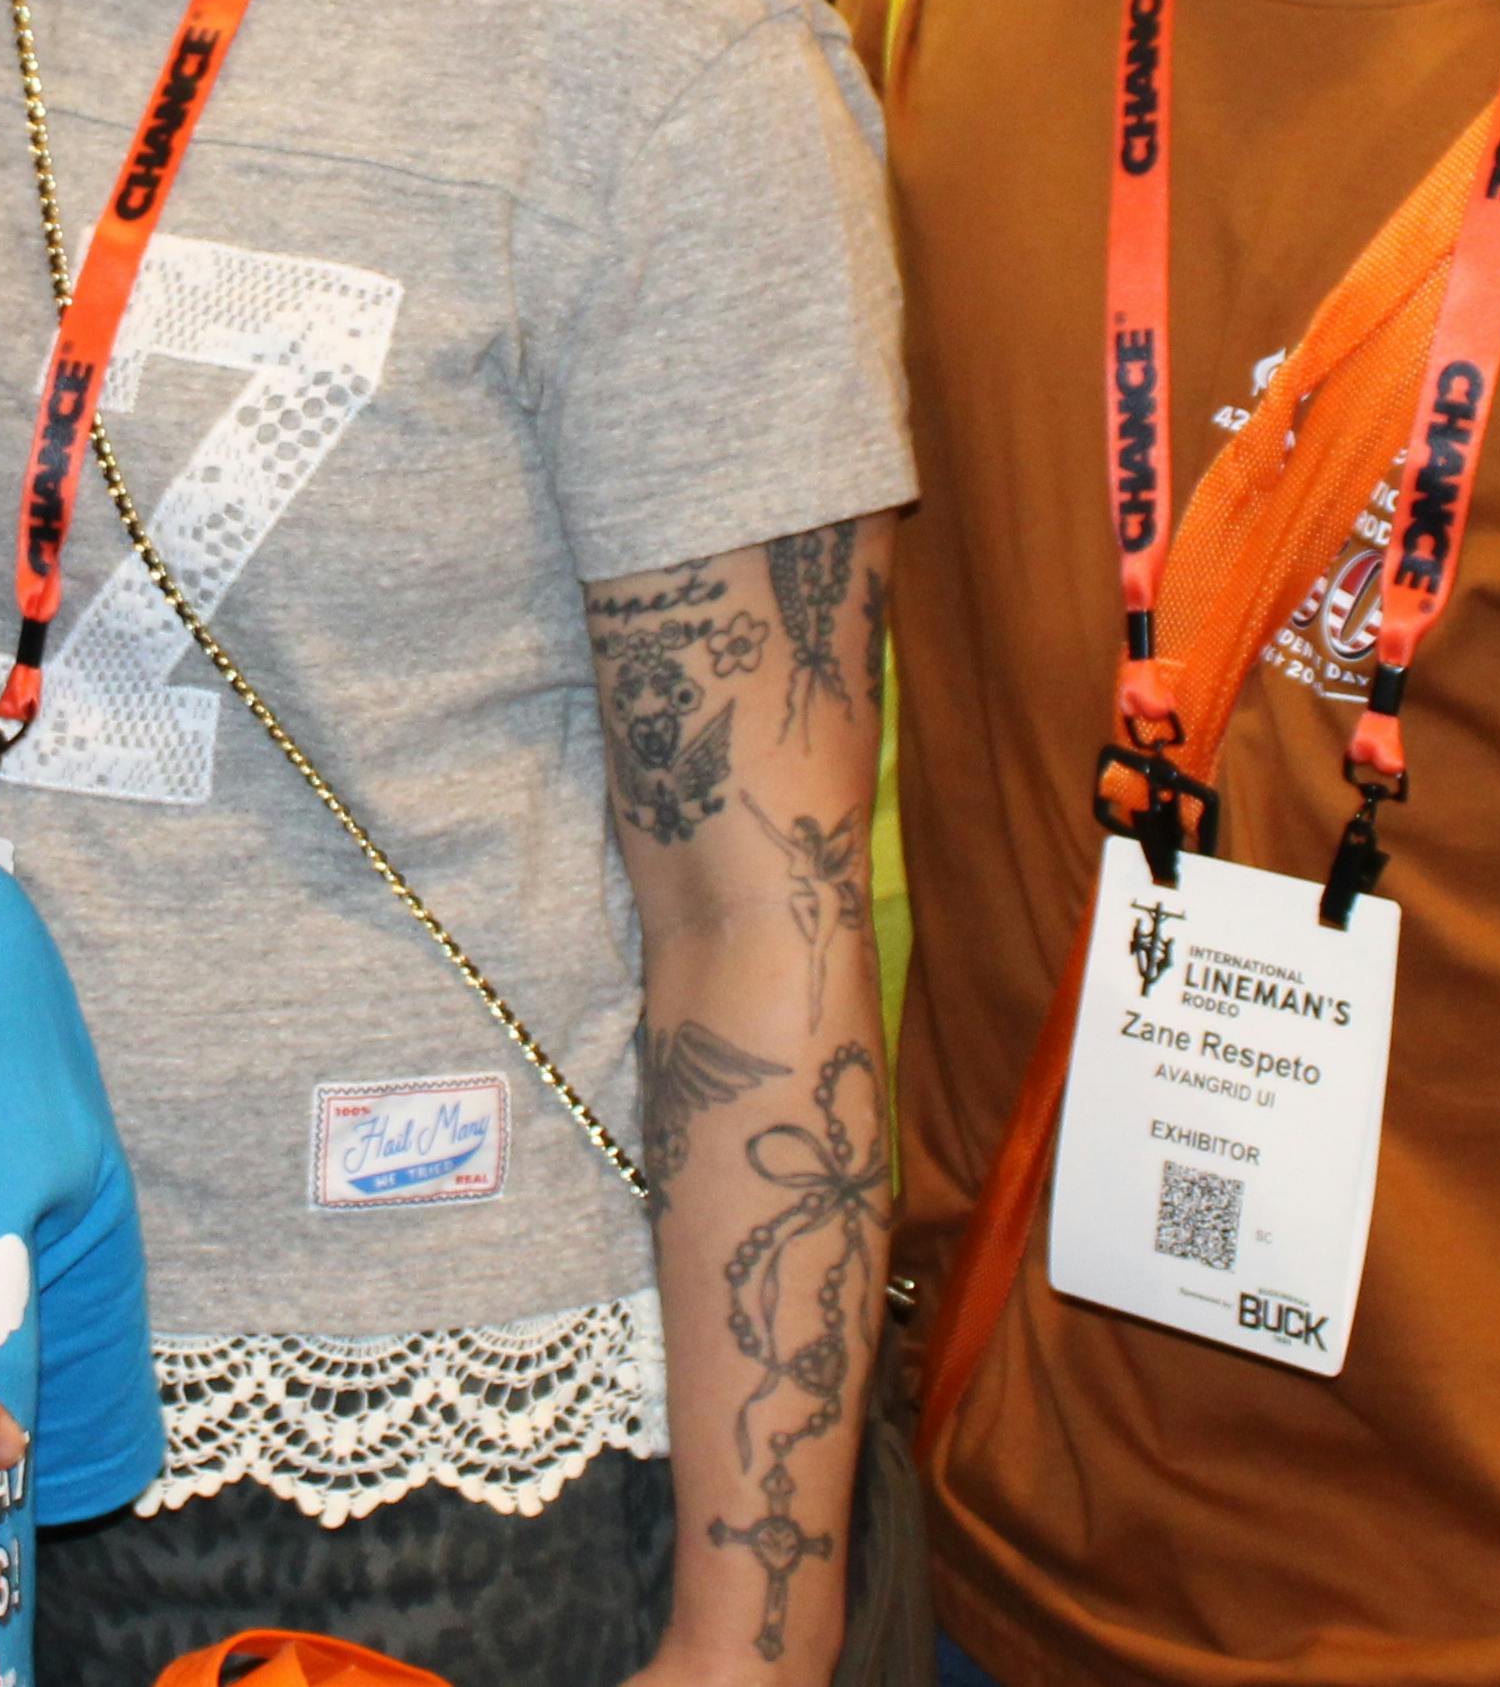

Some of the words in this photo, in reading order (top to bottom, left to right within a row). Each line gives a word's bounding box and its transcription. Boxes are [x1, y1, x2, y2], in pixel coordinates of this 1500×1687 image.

[114, 25, 222, 222] CHANCE
[26, 358, 94, 579] CHANCE
[1115, 327, 1157, 554] CHANCE
[1393, 358, 1485, 596] CHANCE
[1183, 961, 1353, 1027] LINEMAN'S
[1188, 945, 1306, 985] INTERNATIONAL
[1181, 991, 1241, 1018] RODEO
[1120, 1010, 1192, 1052] Zane
[1199, 1030, 1323, 1086] Respeto
[1154, 1062, 1253, 1103] AVANGRID
[1149, 1119, 1262, 1167] EXHIBITOR
[454, 1174, 490, 1186] REAL
[1237, 1290, 1330, 1353] BUCK
